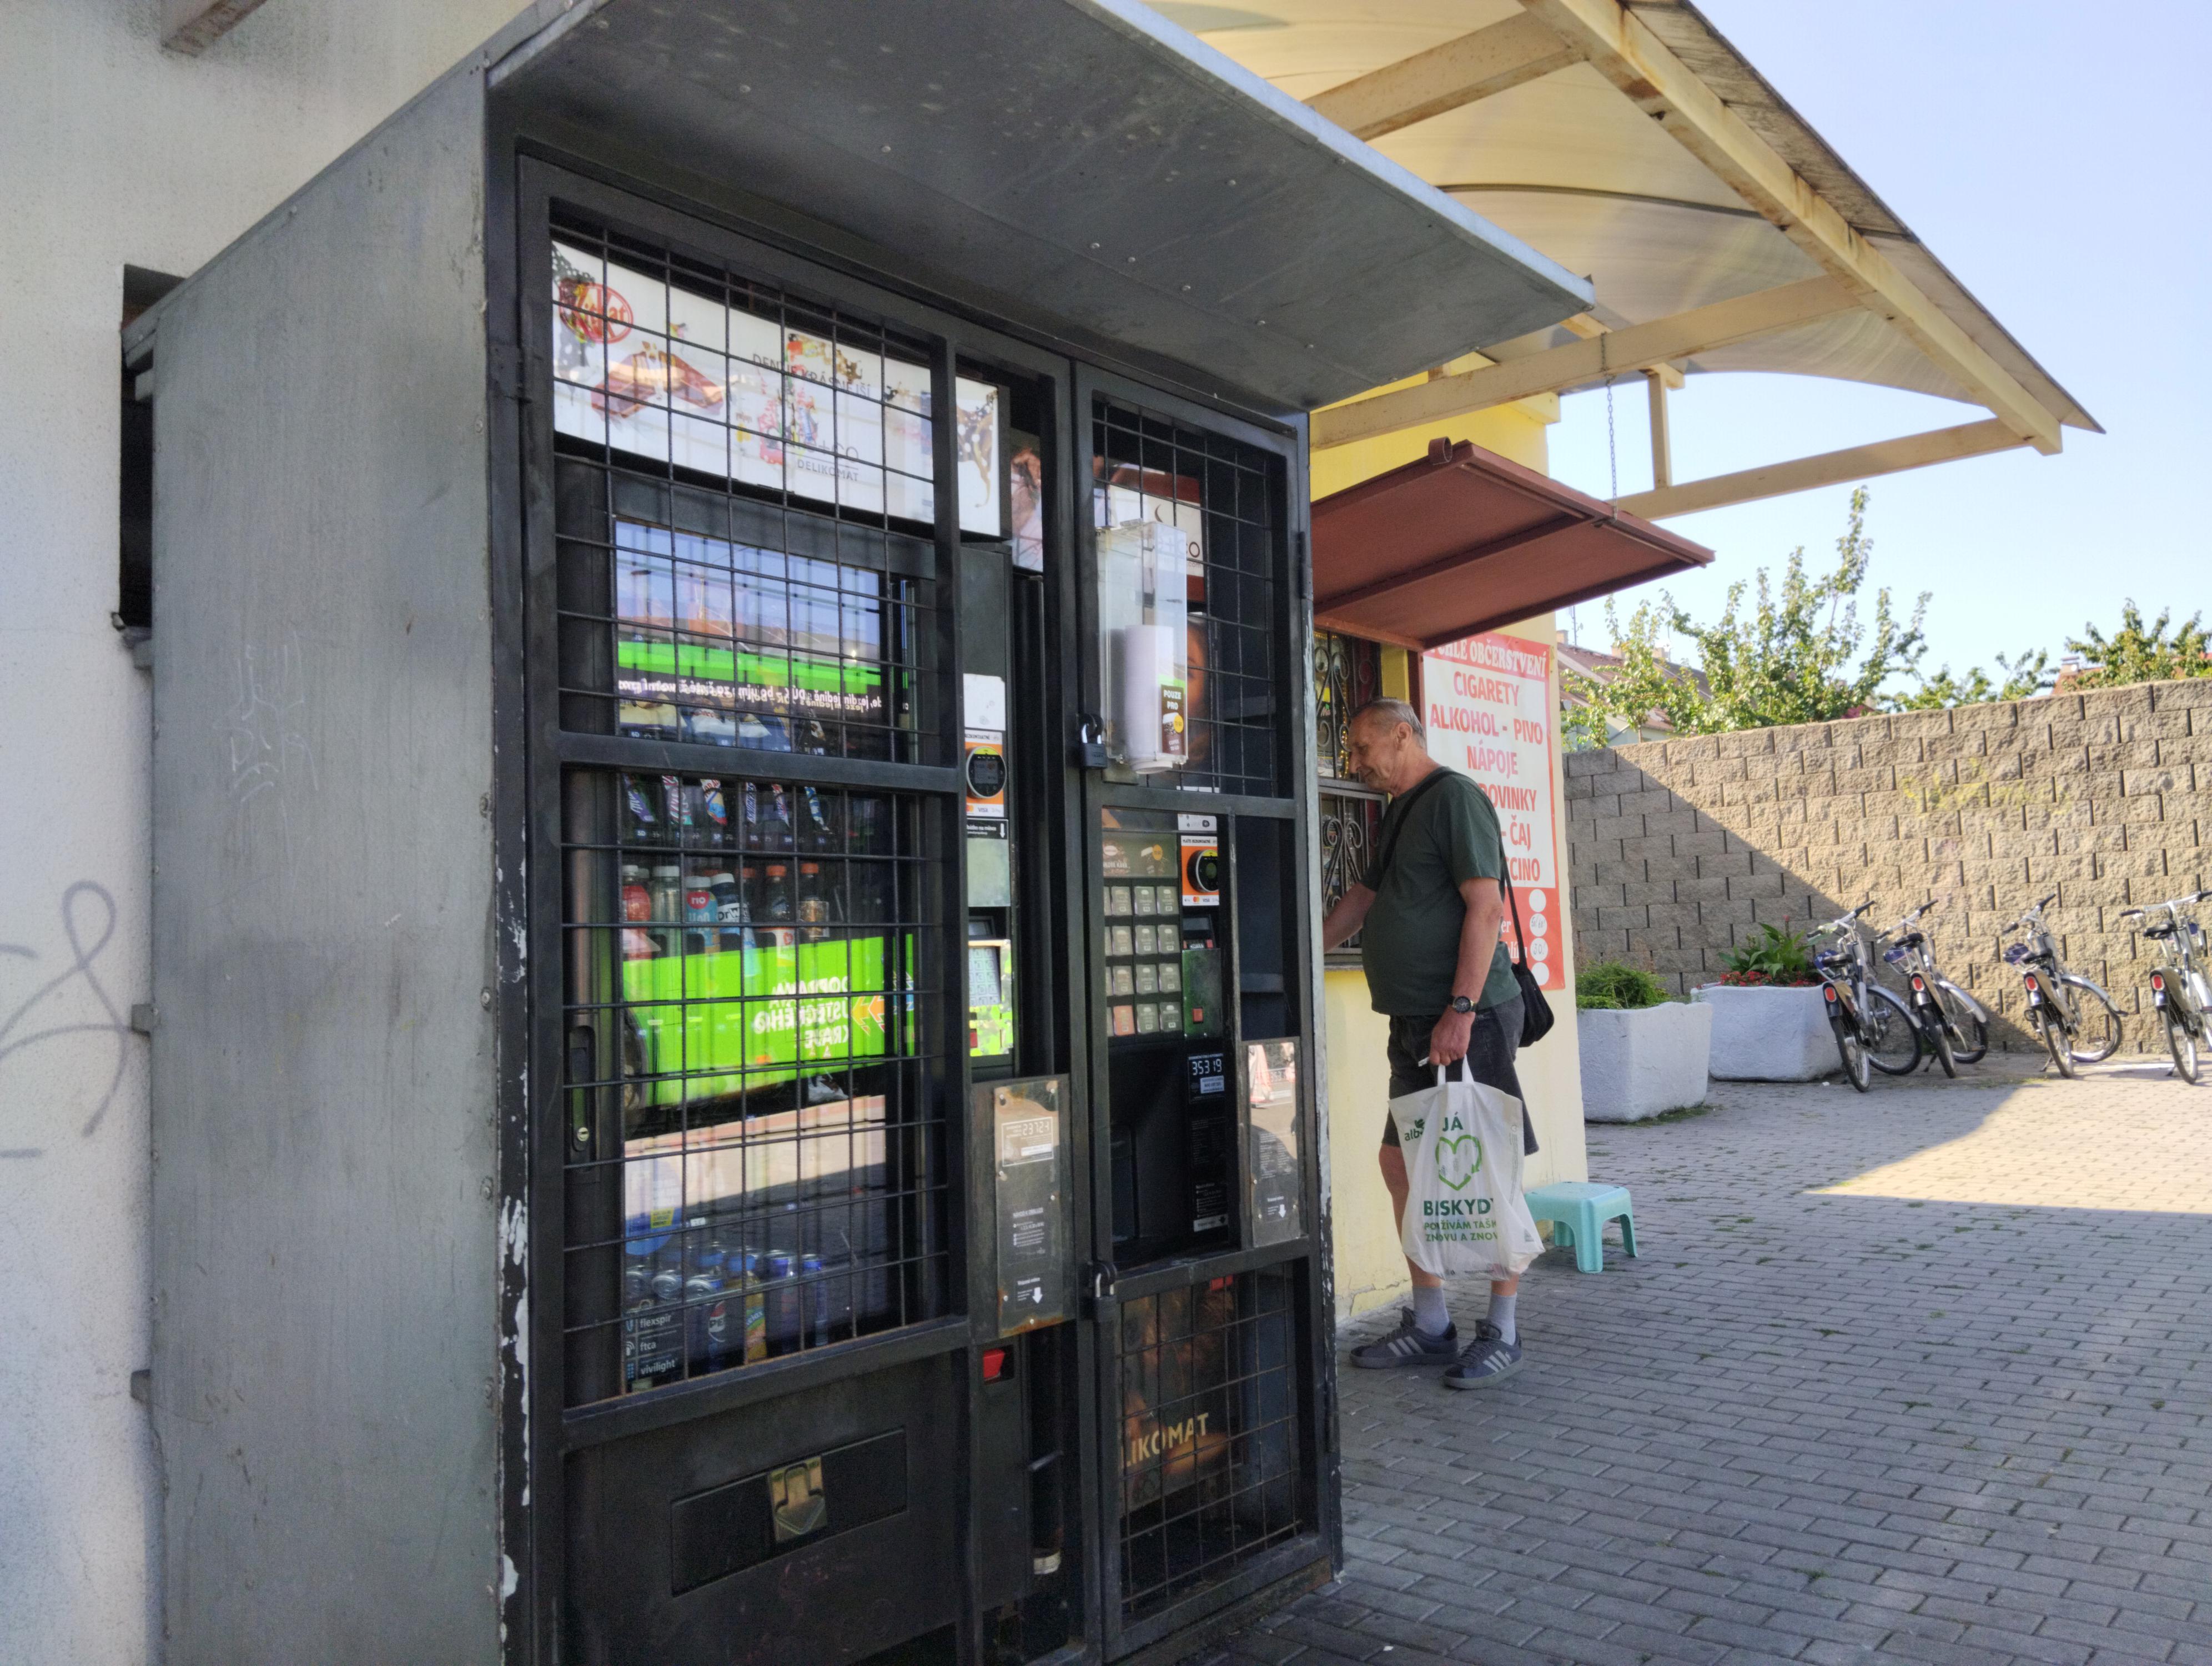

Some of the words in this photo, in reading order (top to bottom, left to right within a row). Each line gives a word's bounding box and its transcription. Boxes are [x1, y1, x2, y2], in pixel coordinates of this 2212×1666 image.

[797, 459, 859, 481] DELIKOMAT
[1470, 638, 1546, 678] OBČERSTVENÍ
[1163, 689, 1182, 700] POUZE
[1453, 671, 1519, 706] CIGARETY
[1167, 701, 1178, 710] PRO
[1430, 704, 1499, 737] ALKOHOL
[1513, 718, 1543, 745] PIVO
[1467, 740, 1519, 779] NÁPOJE
[1510, 815, 1531, 851] ČAJ
[1505, 857, 1540, 882] CINO
[1192, 1058, 1223, 1076] 35319
[1442, 1111, 1464, 1131] JÁ
[1404, 1129, 1424, 1141] alb
[1424, 1198, 1494, 1216] BISKYD
[1426, 1233, 1457, 1242] ZNOVU
[640, 1341, 657, 1351] ftca
[641, 1358, 676, 1374] vivilight
